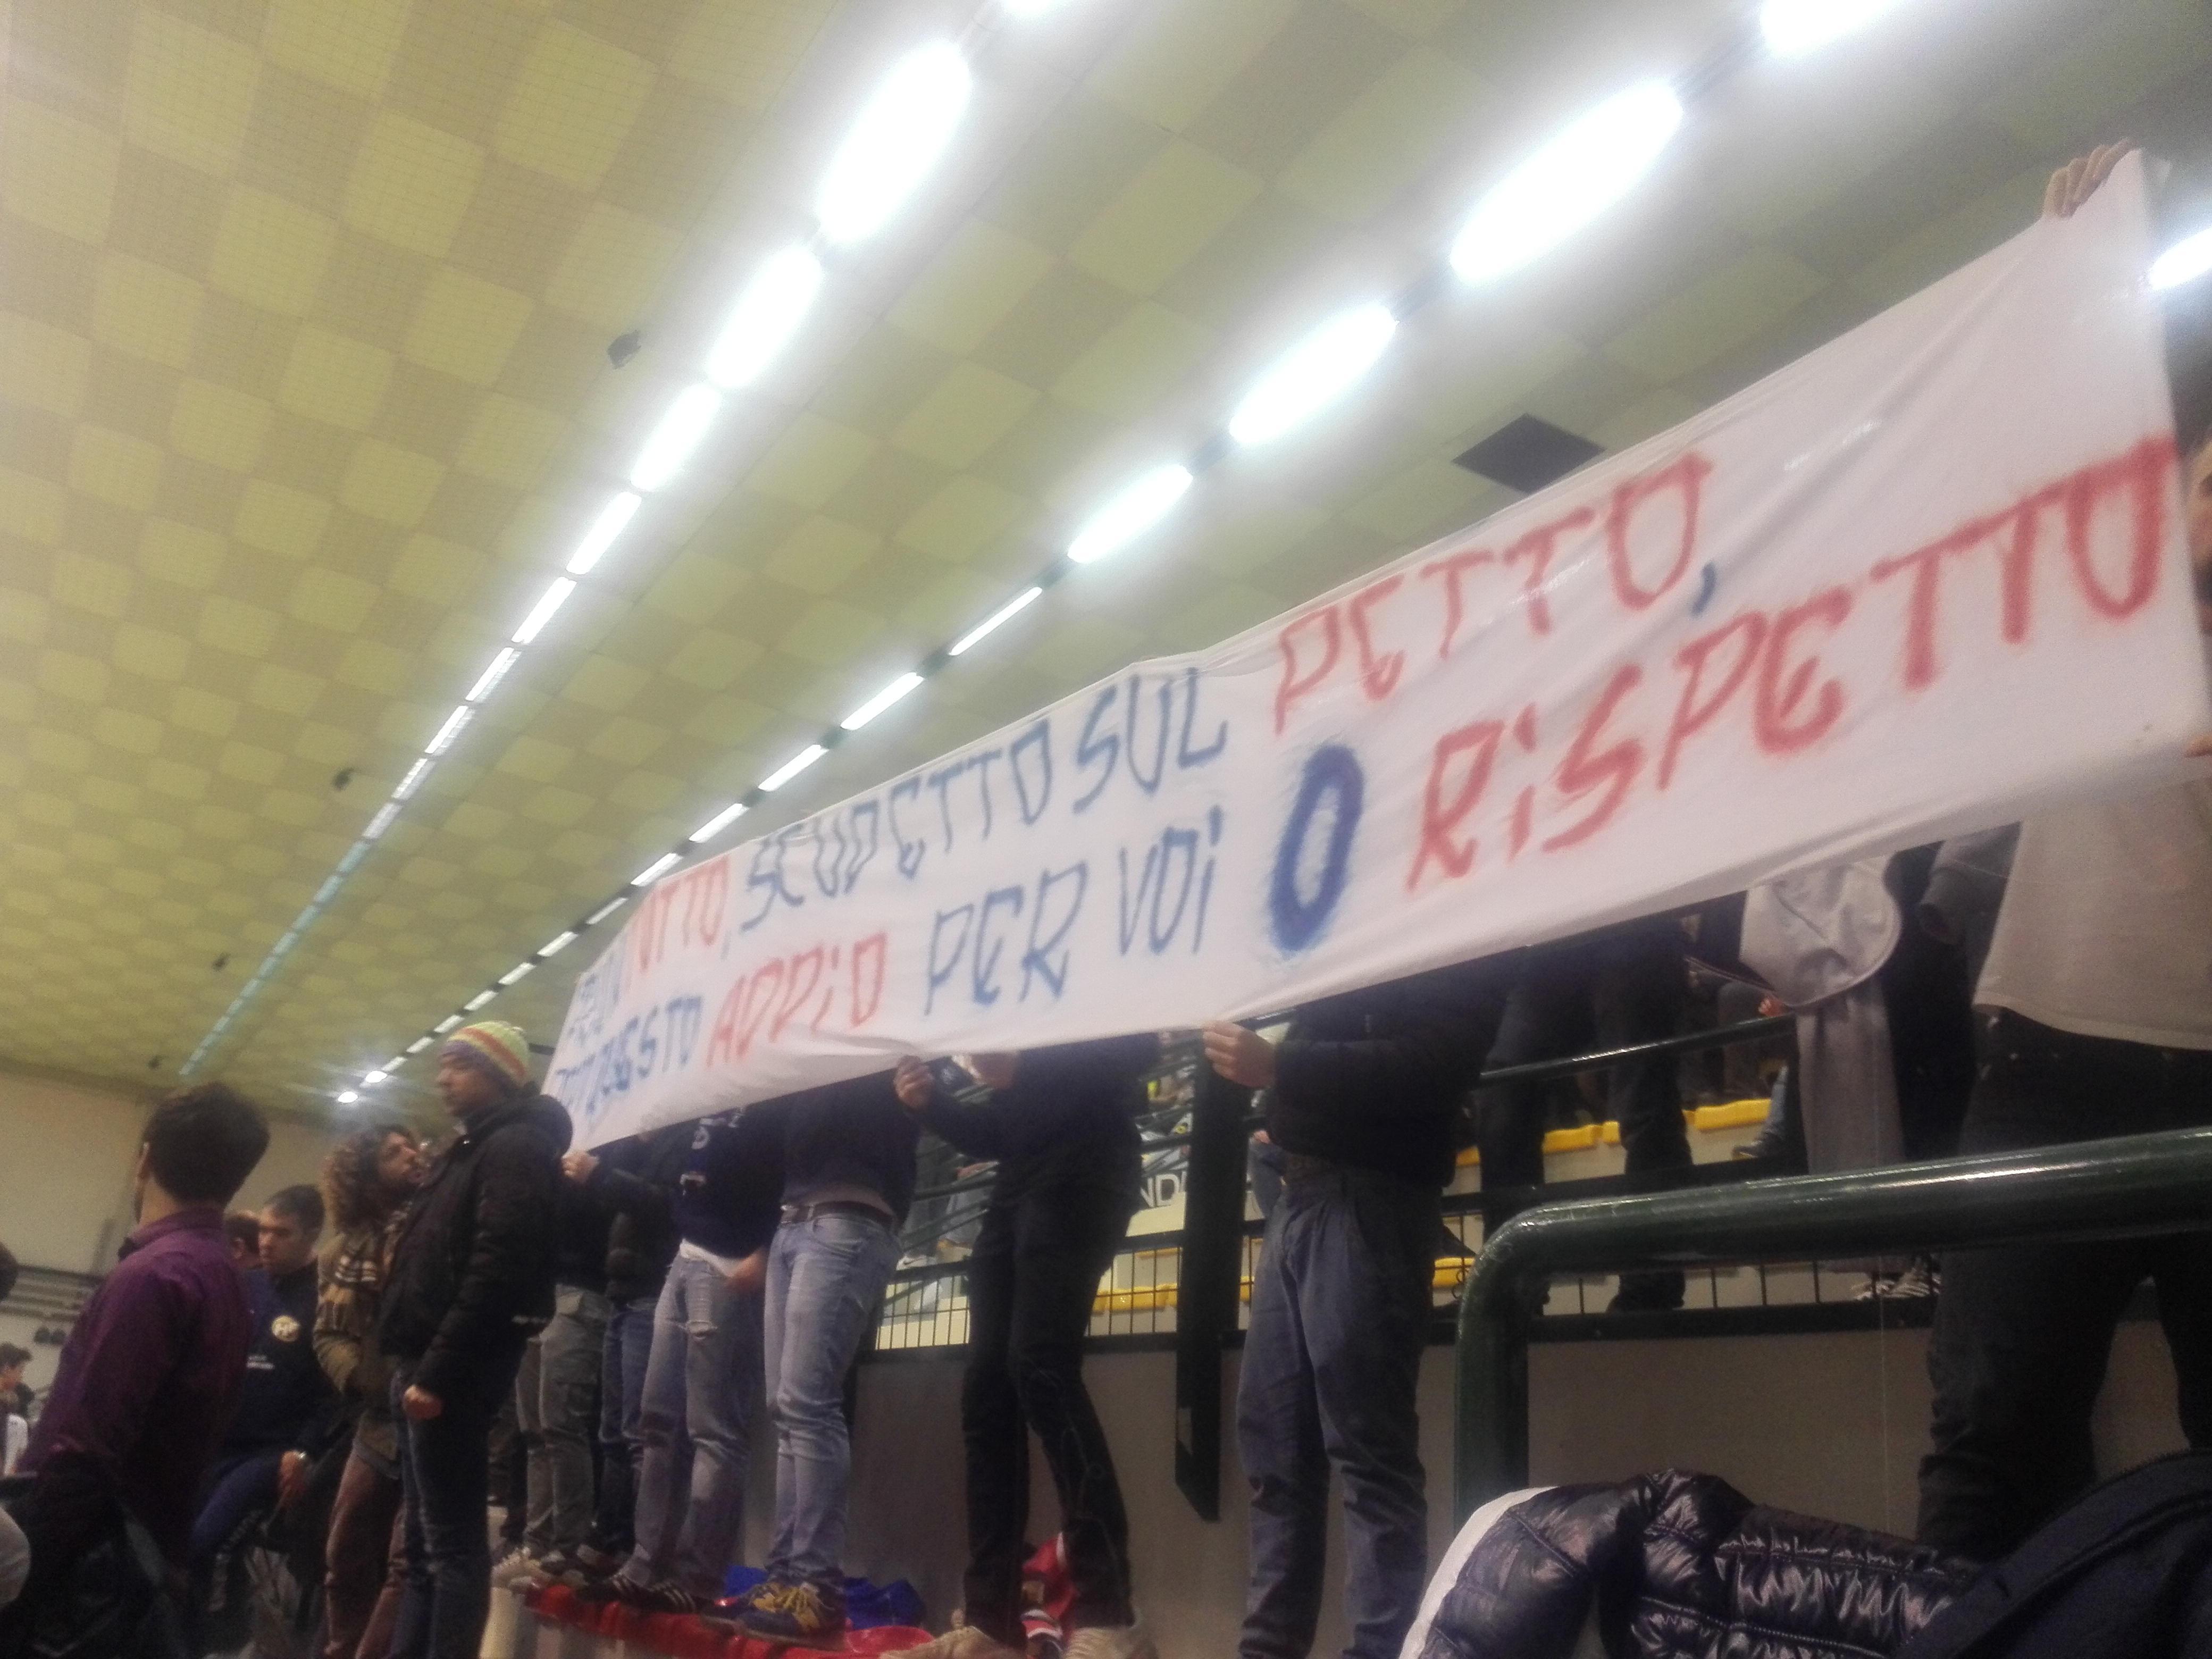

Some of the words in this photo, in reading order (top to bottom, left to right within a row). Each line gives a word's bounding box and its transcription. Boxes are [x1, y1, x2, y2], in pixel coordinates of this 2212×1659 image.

[739, 718, 1053, 933] SCUDETTO
[1073, 667, 1227, 815] SUL
[924, 860, 1089, 1017] PER
